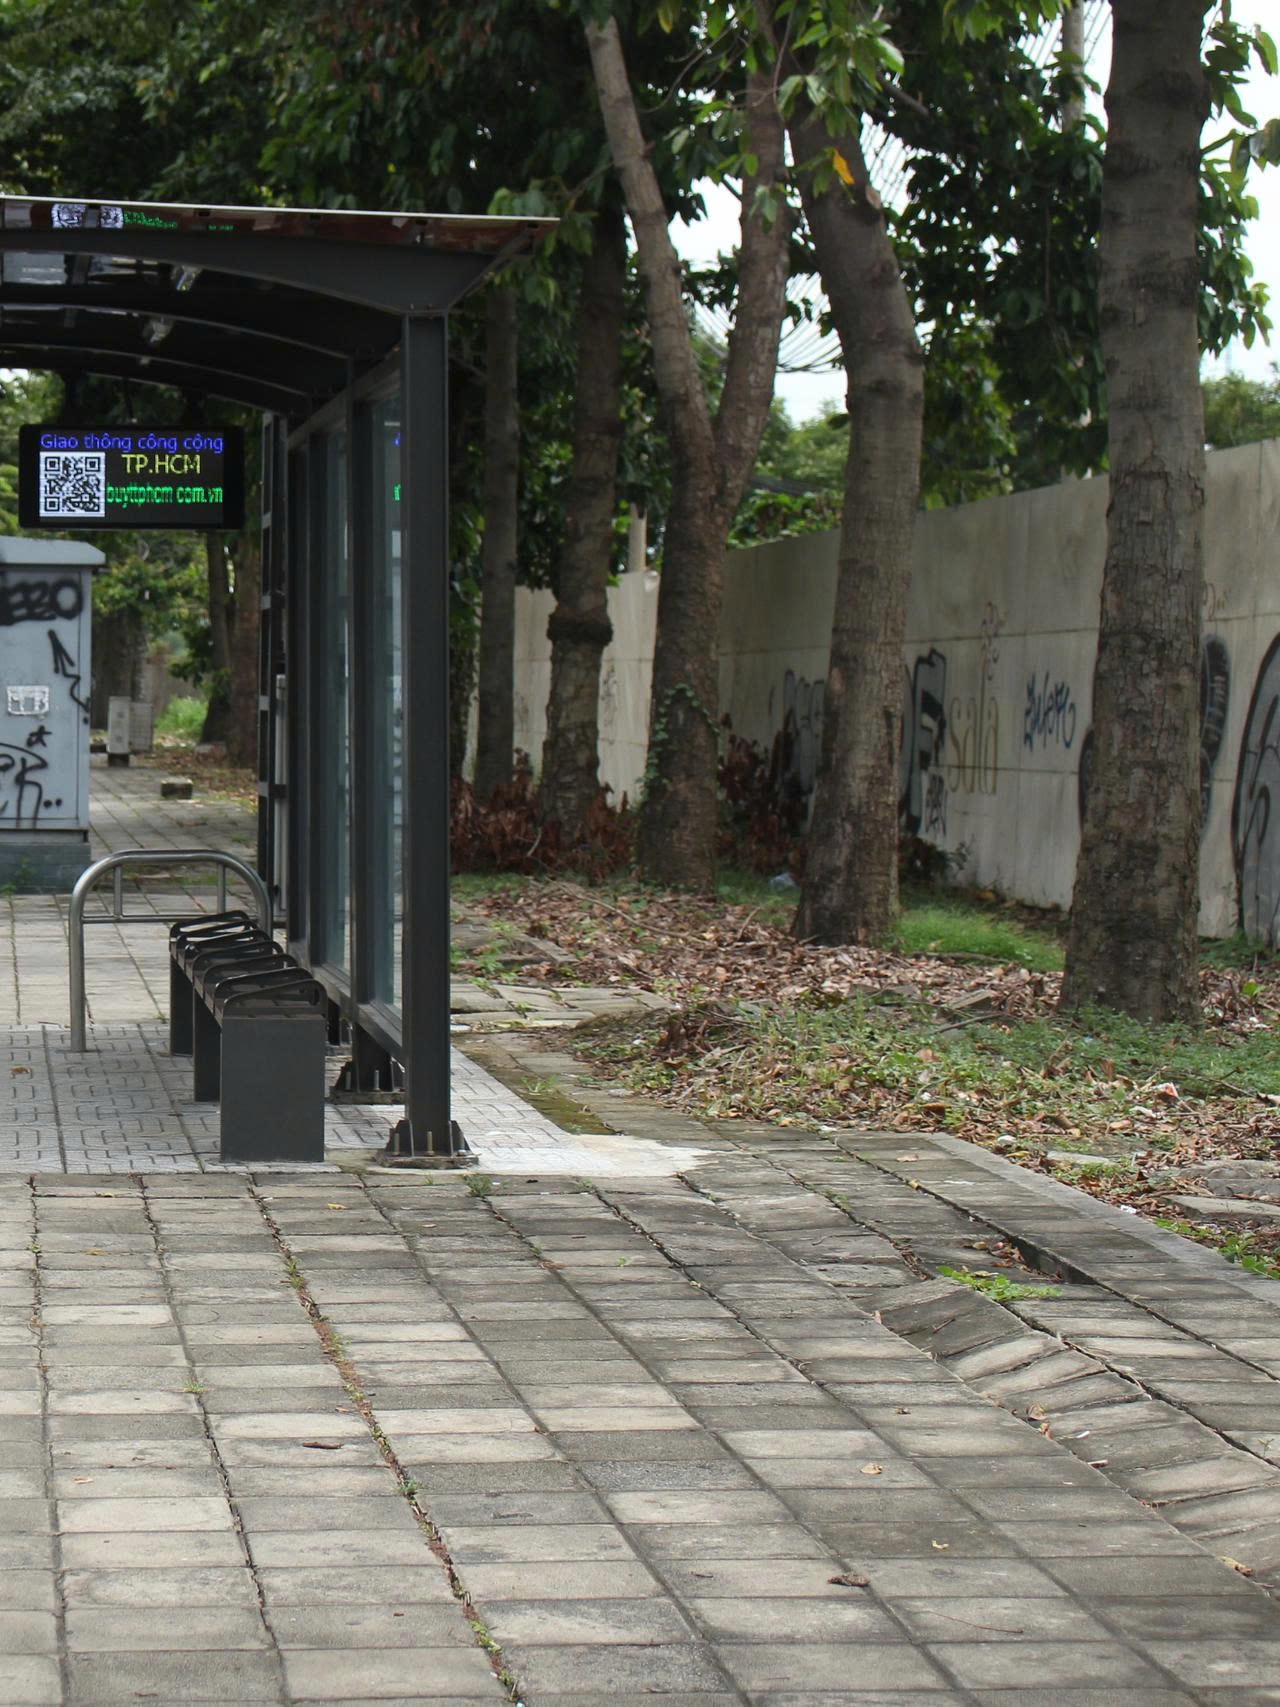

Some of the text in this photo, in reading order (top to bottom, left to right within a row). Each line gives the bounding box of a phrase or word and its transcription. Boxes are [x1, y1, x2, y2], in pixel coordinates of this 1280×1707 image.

[40, 433, 224, 453] Giao thông công cộng
[121, 454, 200, 474] TP.HCM
